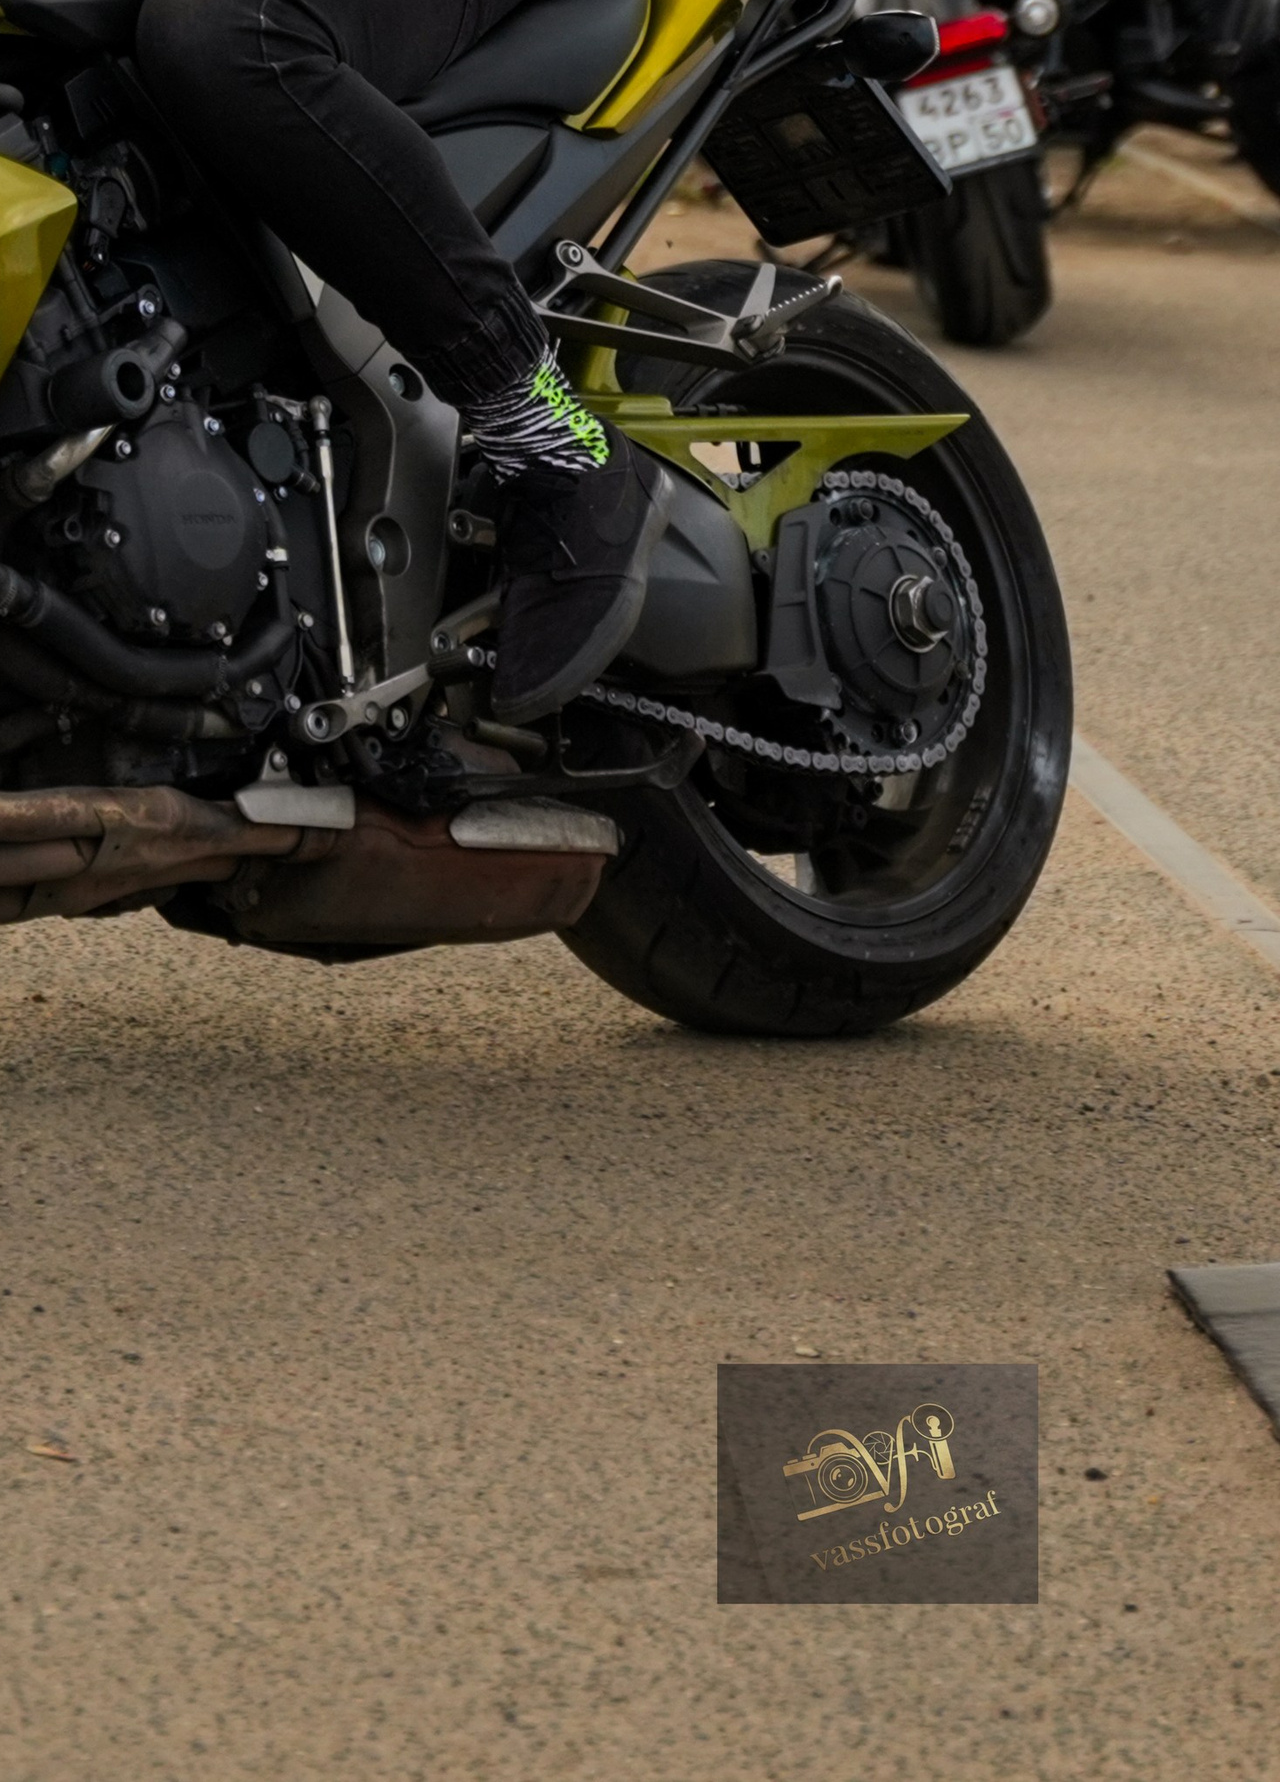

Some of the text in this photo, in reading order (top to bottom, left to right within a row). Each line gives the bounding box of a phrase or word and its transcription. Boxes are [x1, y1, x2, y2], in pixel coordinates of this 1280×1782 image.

[918, 76, 1005, 118] 4263
[981, 118, 1025, 151] 50
[180, 512, 238, 526] HONDA
